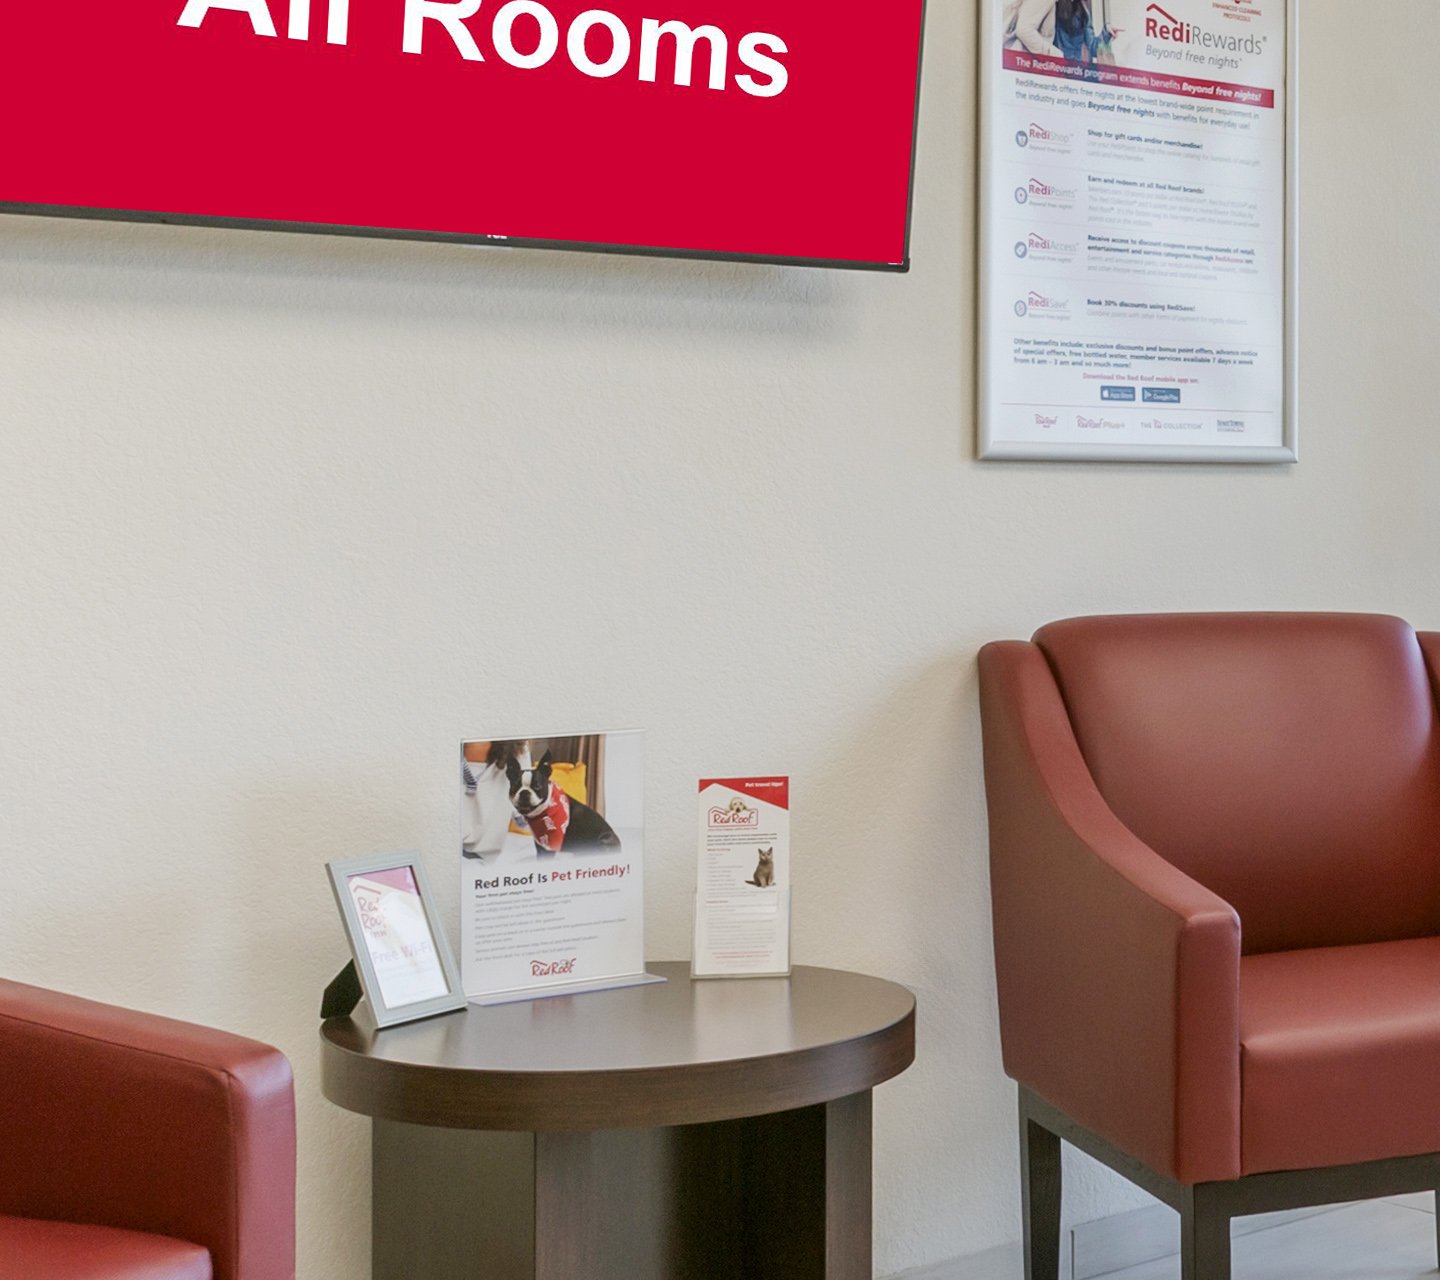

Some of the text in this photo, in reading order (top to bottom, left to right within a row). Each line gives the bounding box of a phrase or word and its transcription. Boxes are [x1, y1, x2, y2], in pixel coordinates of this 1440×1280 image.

[1145, 44, 1239, 69] Beyond free nights
[1016, 57, 1031, 67] The
[1084, 69, 1117, 79] program
[1120, 74, 1150, 84] extends
[1150, 77, 1181, 89] benefits
[1182, 82, 1215, 93] Beyond
[1216, 87, 1233, 96] free
[1088, 101, 1115, 111] Beyond
[1117, 105, 1131, 113] free
[1133, 107, 1155, 117] nights
[474, 864, 631, 890] Red Roof Is Pet Friendly!
[532, 963, 550, 977] Red
